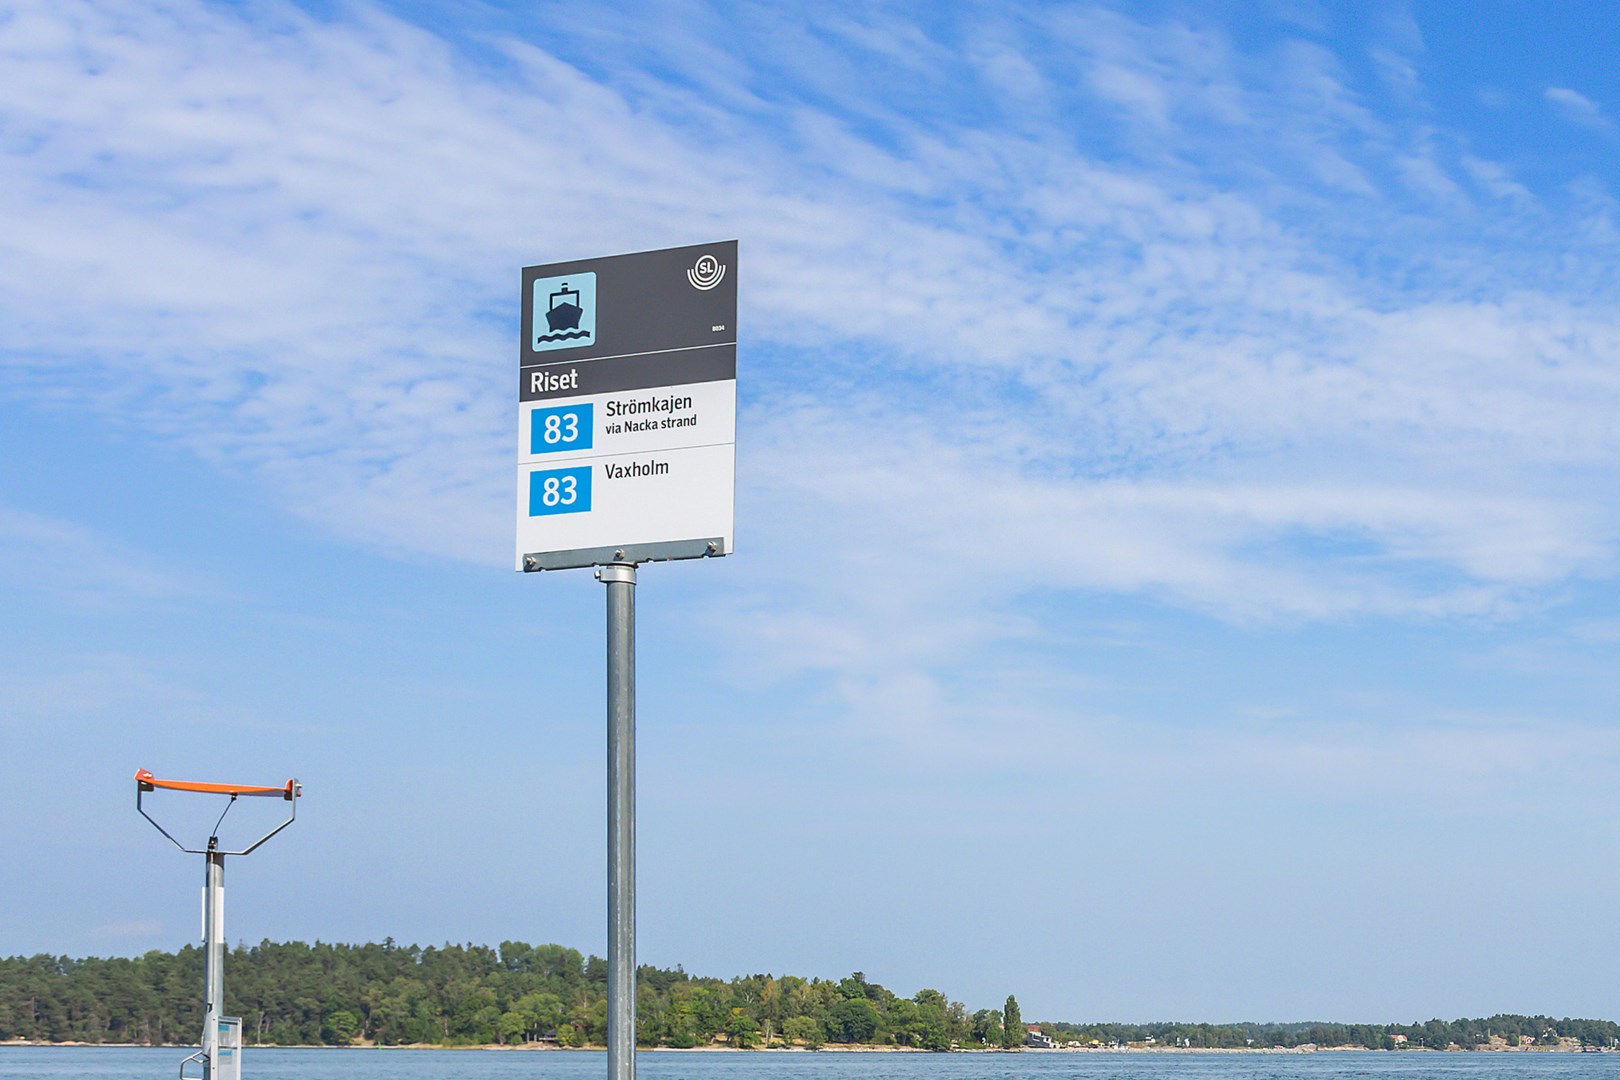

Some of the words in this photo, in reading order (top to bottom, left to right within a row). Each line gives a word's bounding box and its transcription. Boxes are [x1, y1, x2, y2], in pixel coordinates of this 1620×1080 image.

[699, 261, 714, 274] SL
[531, 368, 578, 393] Riset
[606, 395, 692, 417] Strömkajen
[544, 413, 579, 444] 83
[605, 422, 622, 435] via
[624, 419, 658, 433] Nacka
[661, 414, 697, 429] strand
[605, 459, 669, 480] Vaxholm
[542, 475, 578, 507] 83
